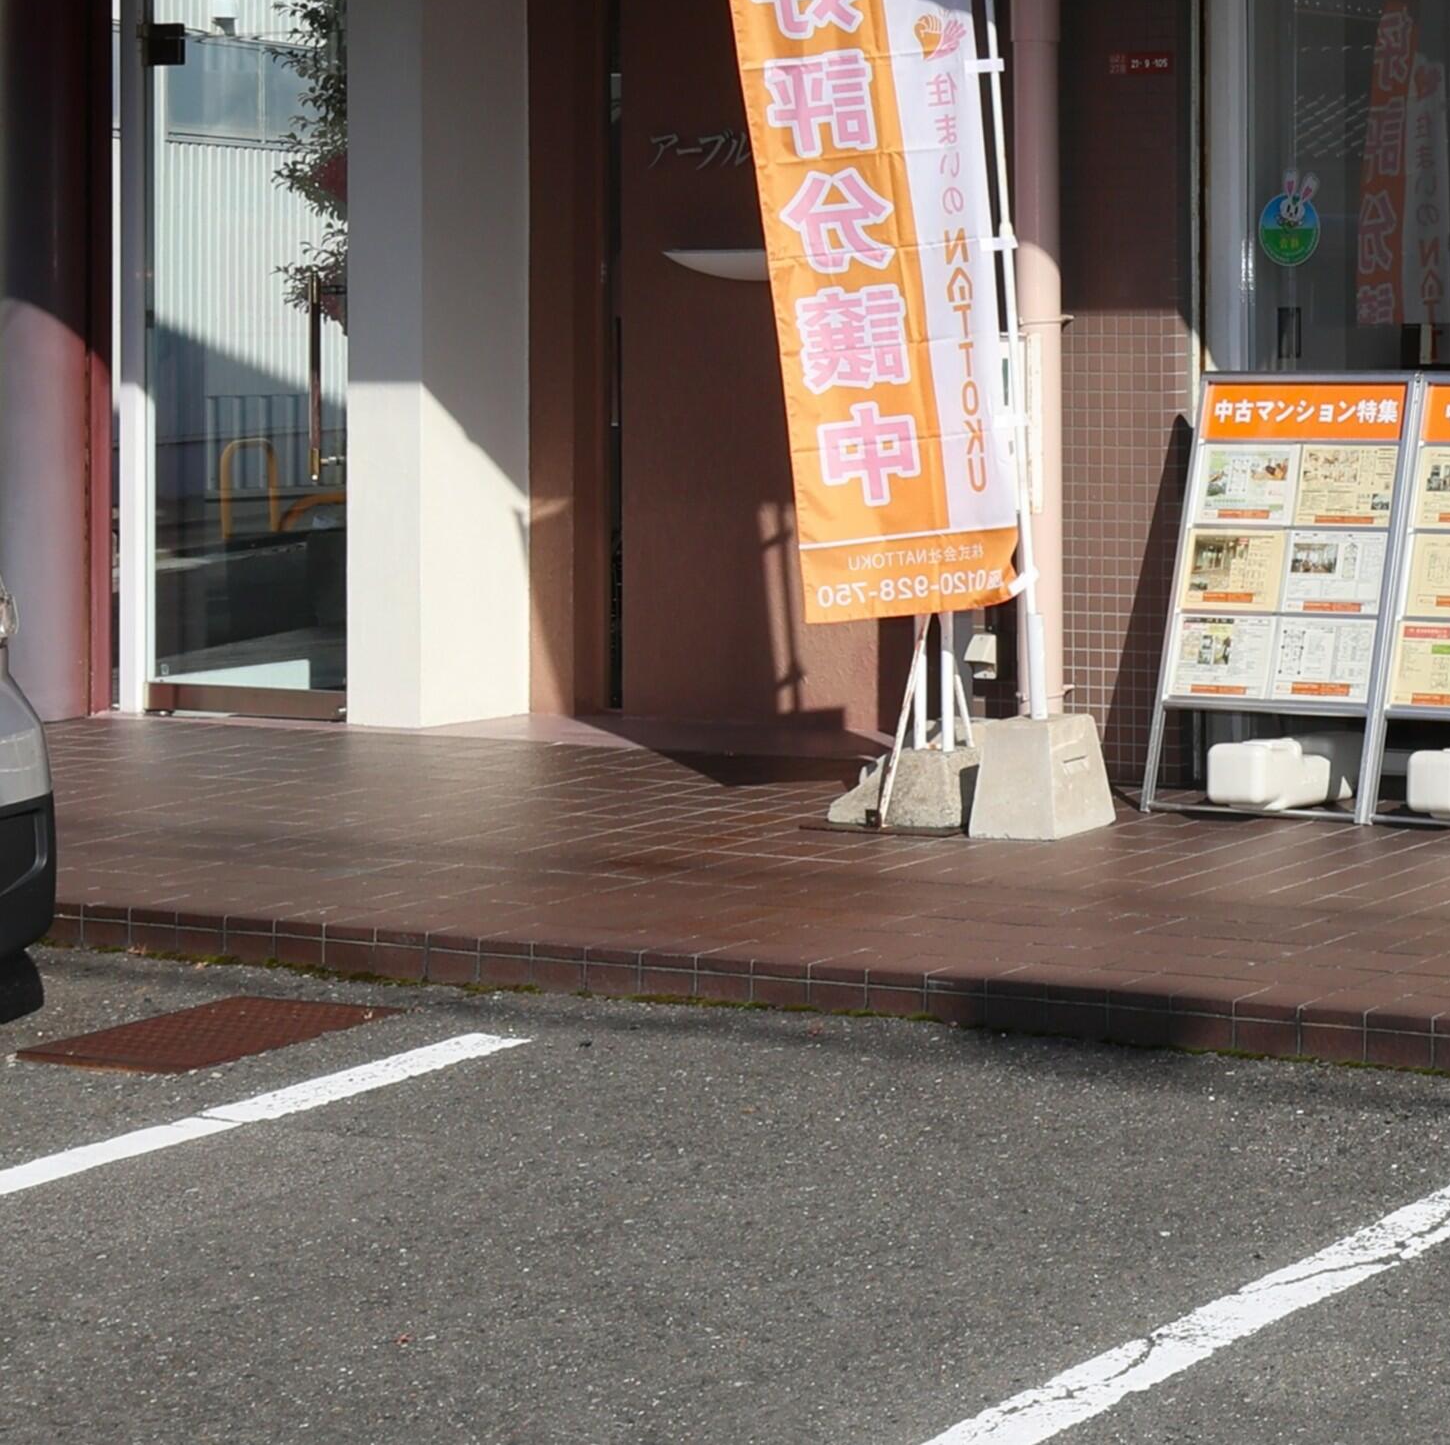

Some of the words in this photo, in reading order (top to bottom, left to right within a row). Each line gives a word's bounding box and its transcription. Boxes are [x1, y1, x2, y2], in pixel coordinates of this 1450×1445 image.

[1213, 400, 1399, 425] 中古マンション特集
